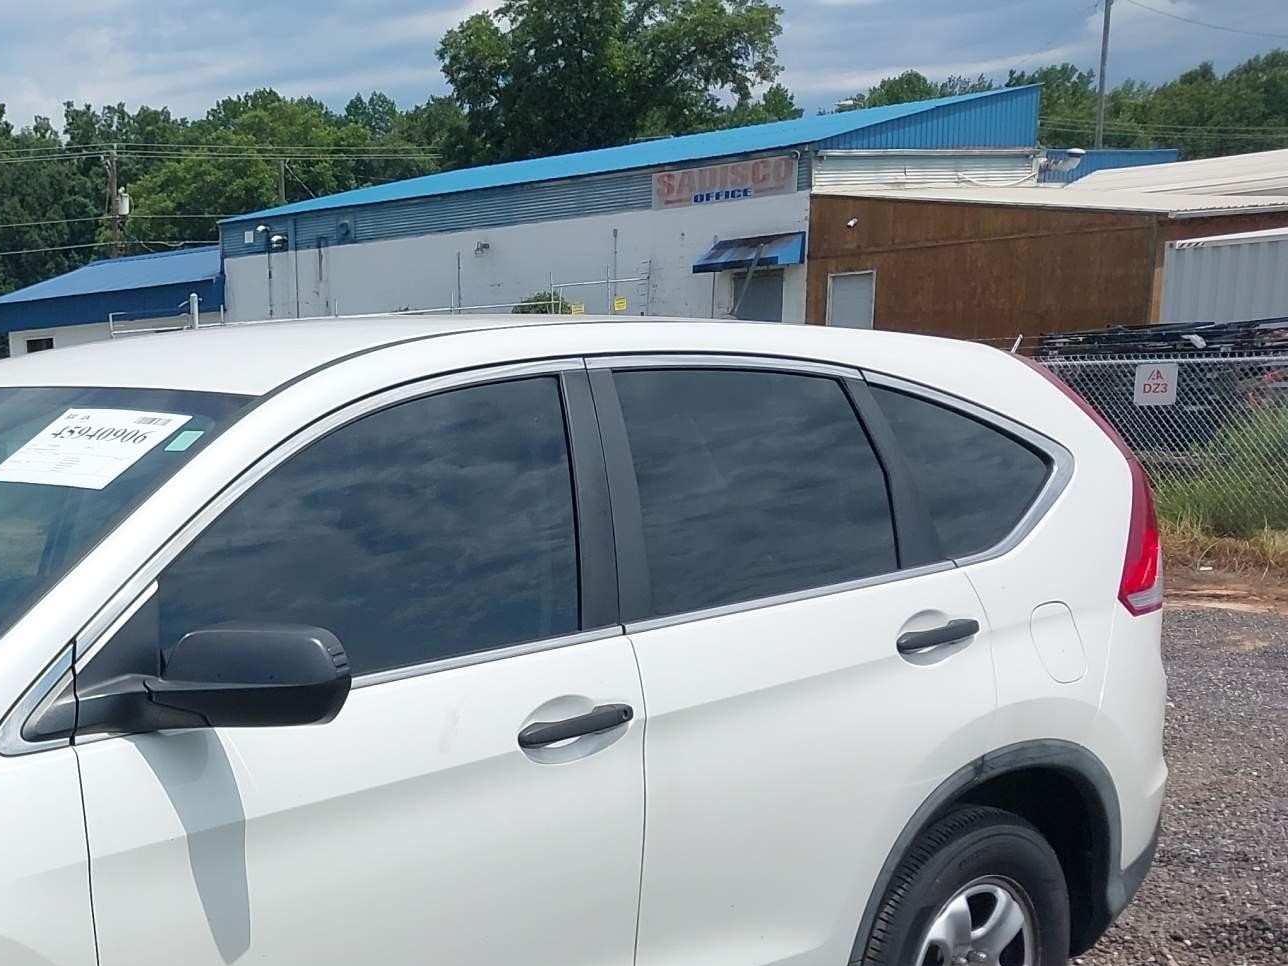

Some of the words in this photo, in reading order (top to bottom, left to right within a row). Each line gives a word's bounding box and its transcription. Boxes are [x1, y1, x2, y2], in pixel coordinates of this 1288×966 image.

[693, 187, 753, 203] OFFICE
[1143, 383, 1168, 394] DZ3
[51, 426, 154, 444] 45940906
